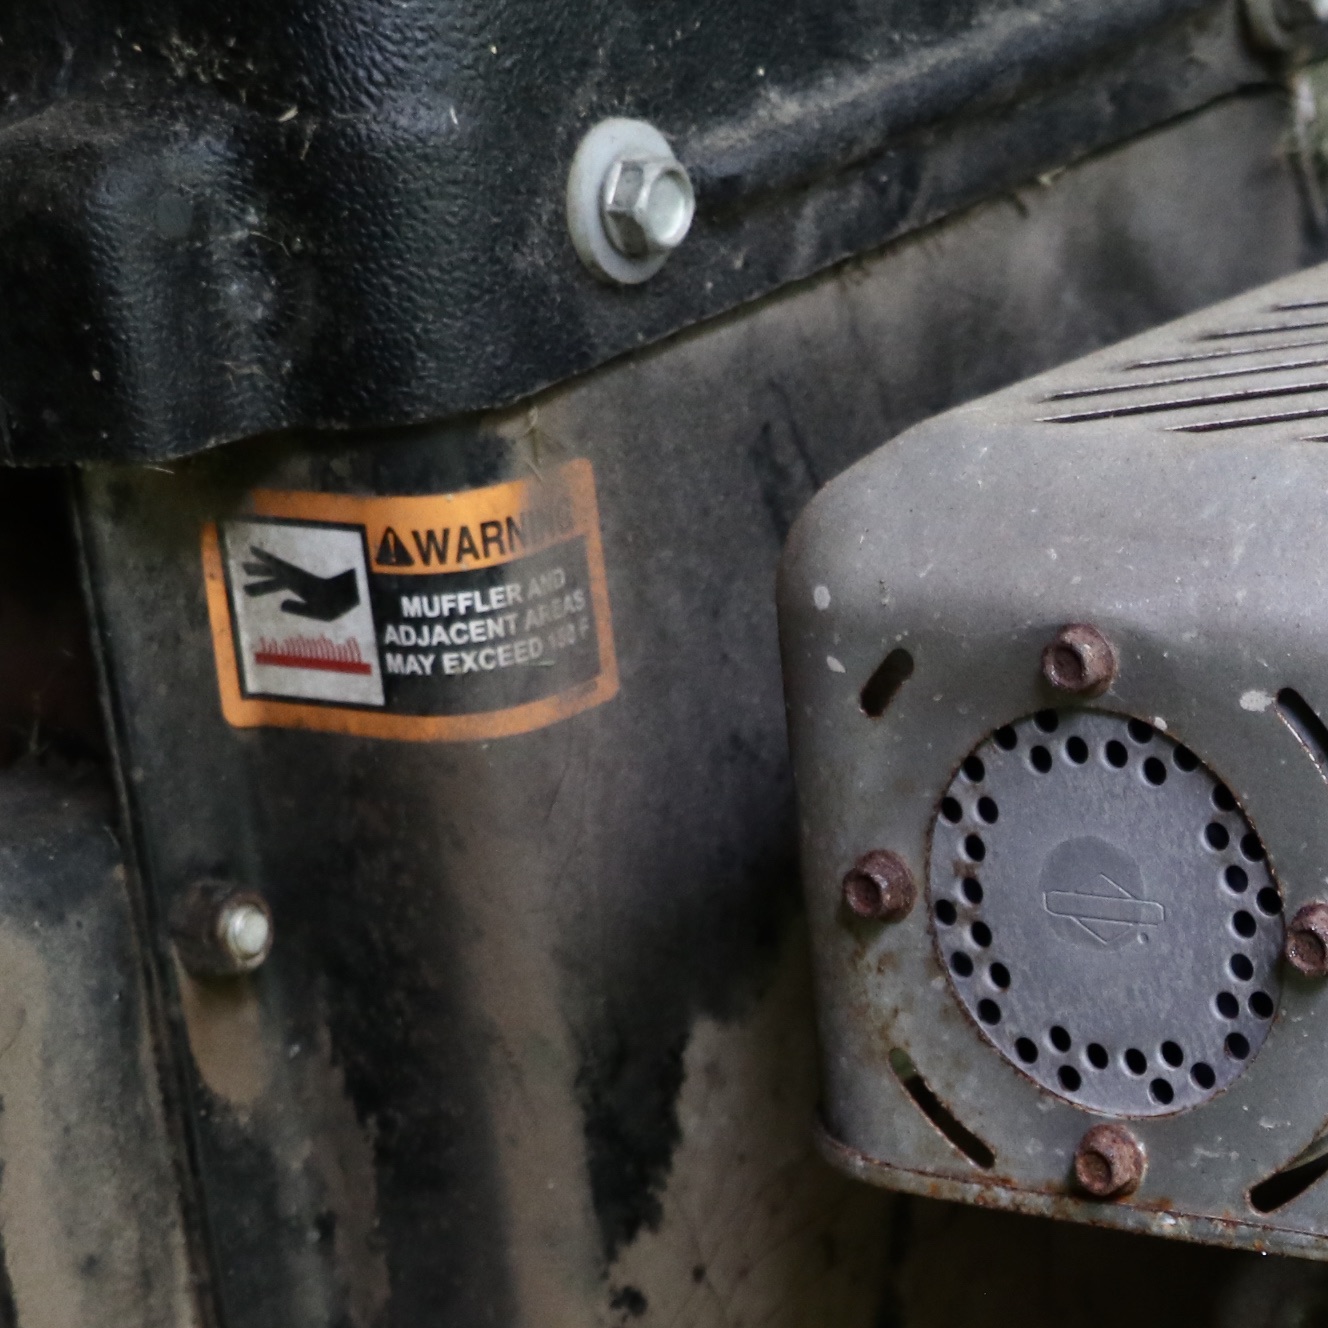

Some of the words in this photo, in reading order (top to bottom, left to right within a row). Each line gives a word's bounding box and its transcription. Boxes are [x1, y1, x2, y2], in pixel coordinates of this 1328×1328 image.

[411, 502, 575, 566] WARN
[402, 583, 523, 618] MUFFLER
[384, 613, 518, 646] ADJACENT
[385, 652, 435, 676] MAY
[442, 636, 544, 676] EXCEED
